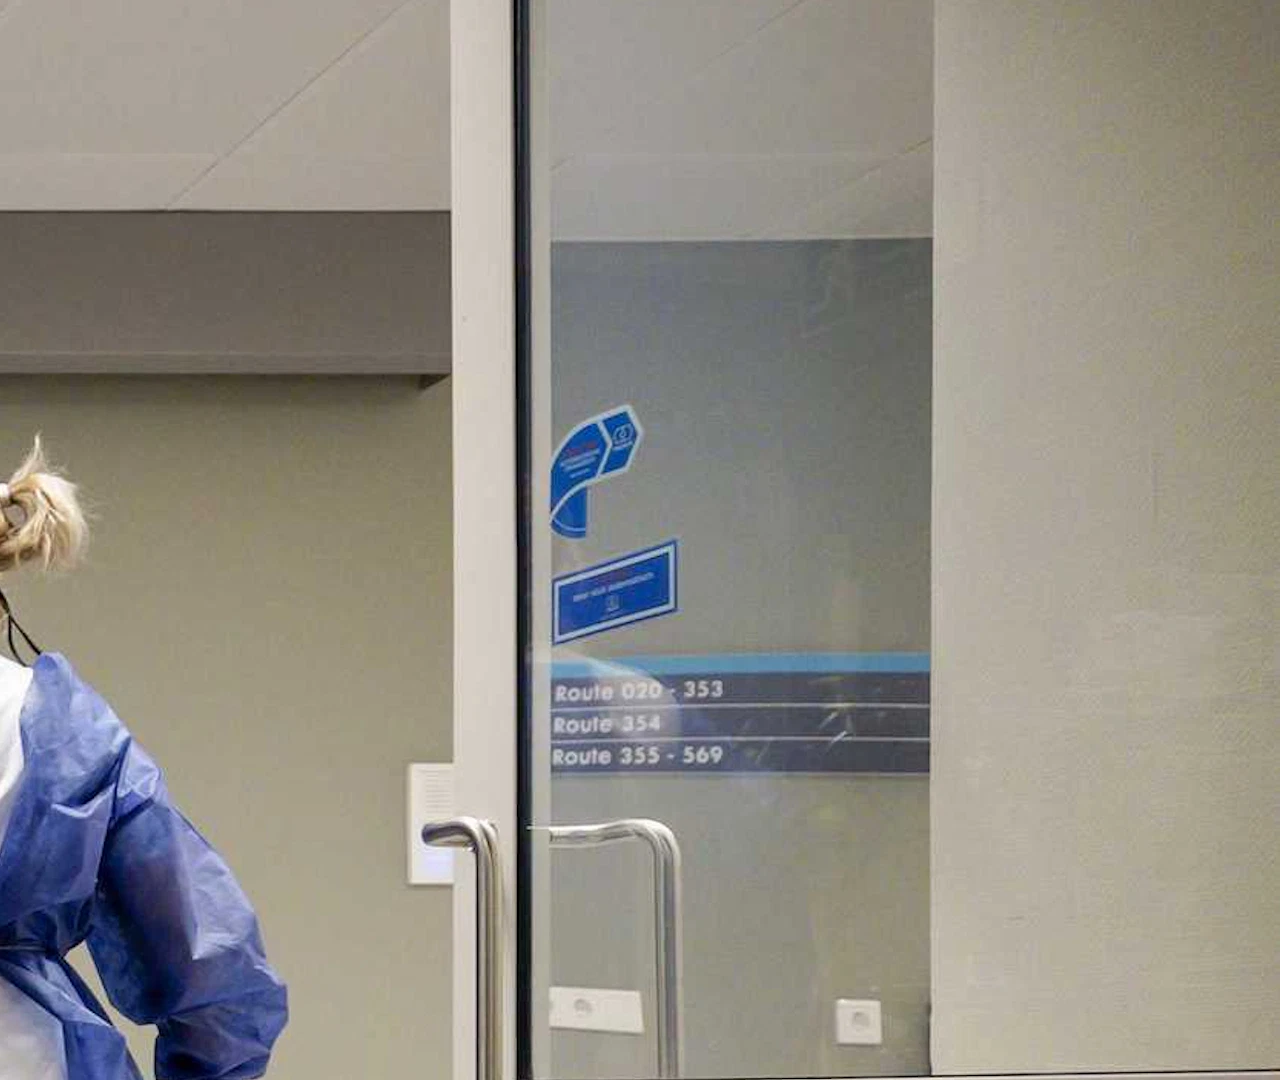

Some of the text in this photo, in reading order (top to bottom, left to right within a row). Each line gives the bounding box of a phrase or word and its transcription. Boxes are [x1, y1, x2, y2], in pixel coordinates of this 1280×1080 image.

[555, 685, 613, 701] Route
[622, 682, 662, 699] 020
[684, 680, 723, 697] 353
[553, 715, 660, 733] Route 354
[552, 748, 612, 765] Route
[620, 746, 660, 764] 355
[684, 746, 723, 763] 569
